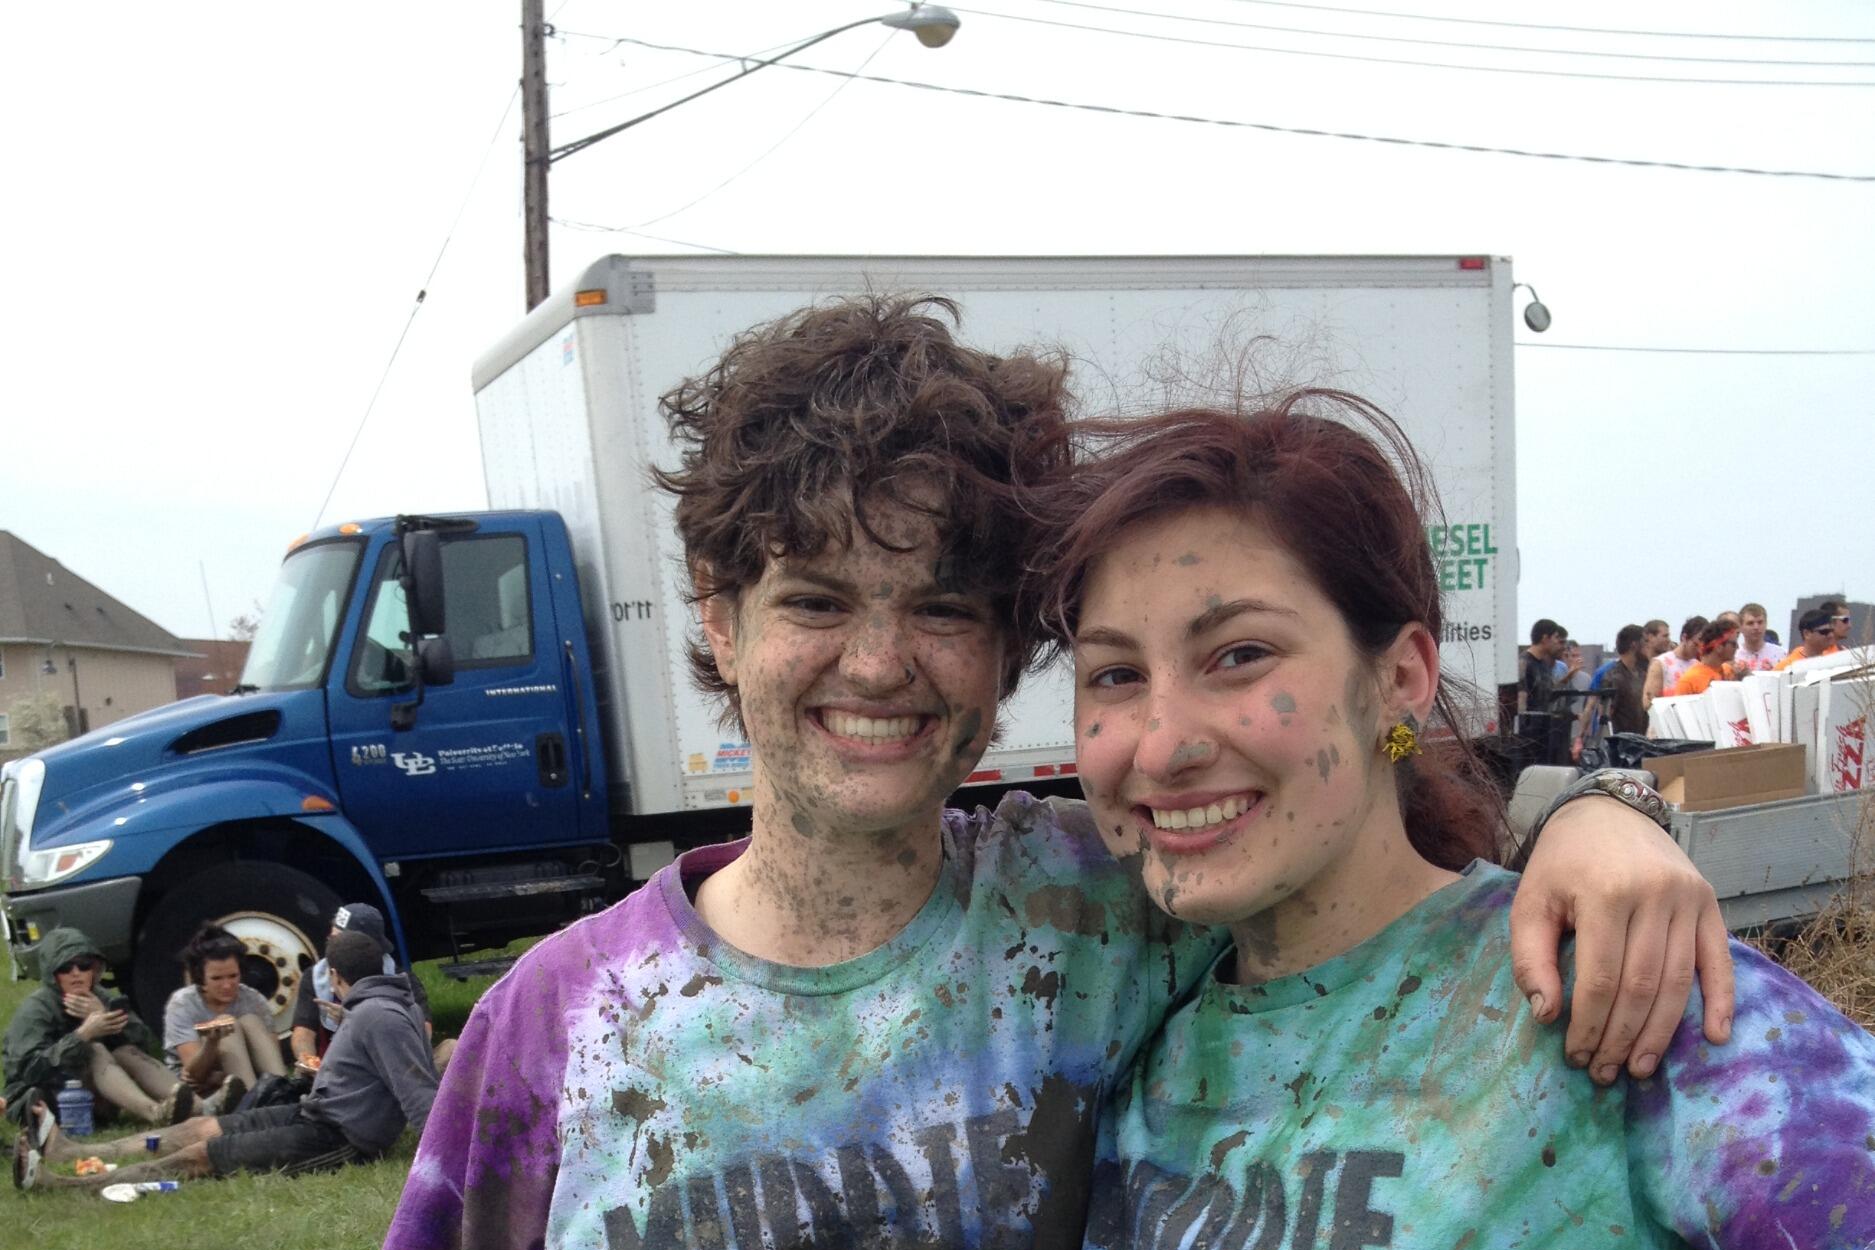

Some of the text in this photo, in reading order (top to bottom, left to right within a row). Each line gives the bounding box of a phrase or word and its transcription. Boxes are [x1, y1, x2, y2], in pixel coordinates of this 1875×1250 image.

[1439, 557, 1489, 590] EET
[1440, 620, 1492, 643] lities
[485, 684, 557, 697] INTERNATIONAL
[1842, 714, 1867, 792] ZZA
